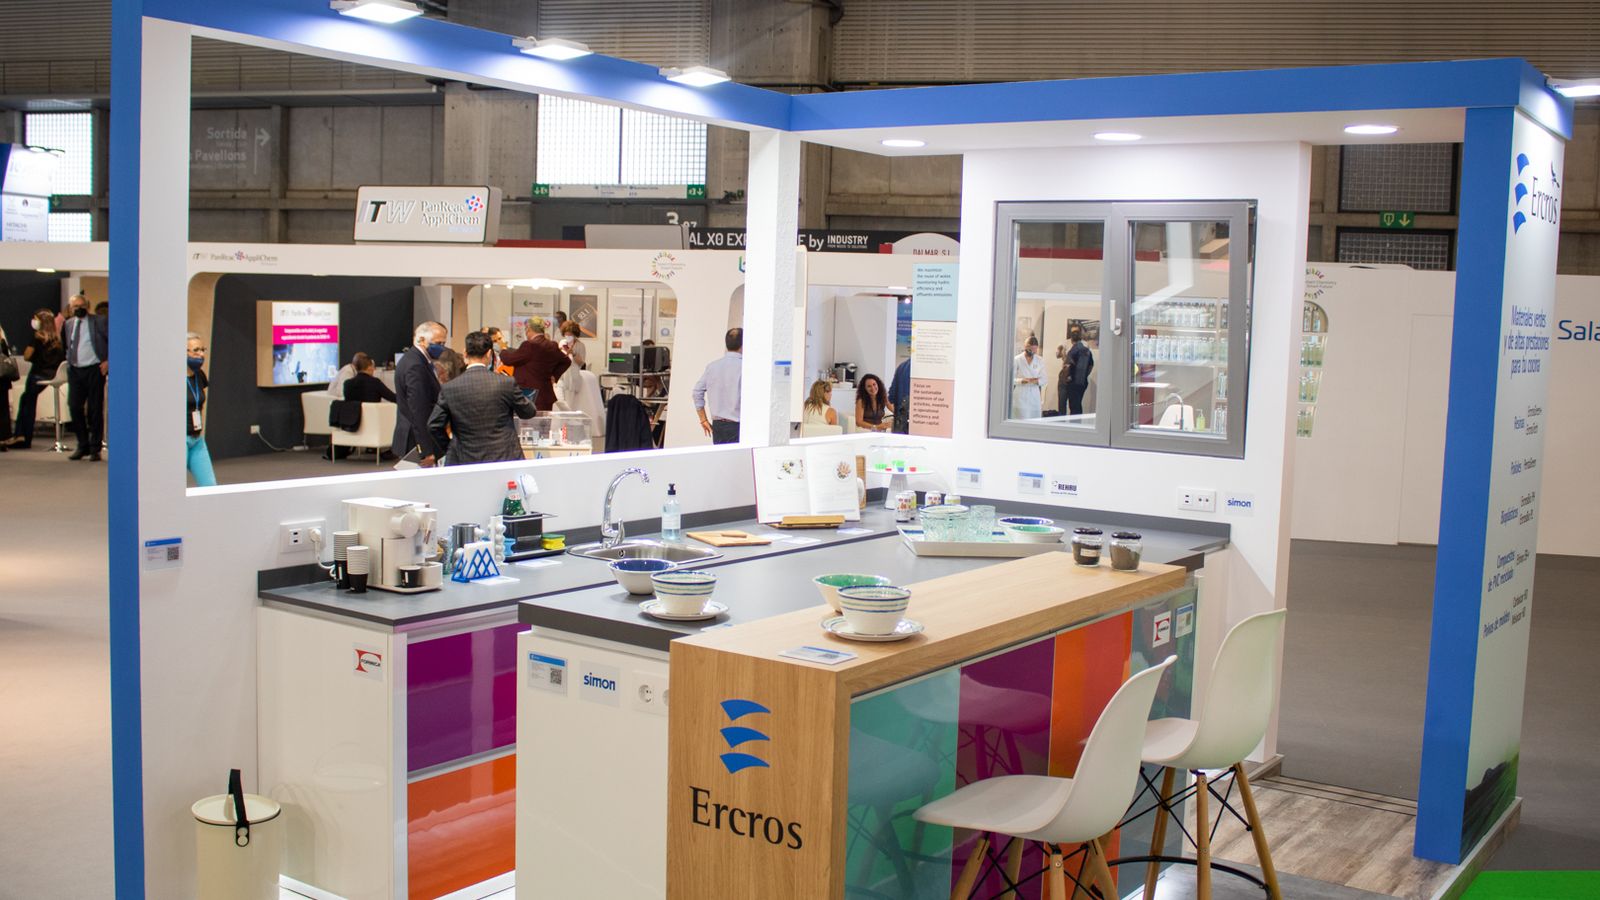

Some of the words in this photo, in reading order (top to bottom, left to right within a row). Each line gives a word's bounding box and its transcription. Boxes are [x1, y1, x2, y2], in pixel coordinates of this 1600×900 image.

[207, 127, 247, 140] Sortida
[195, 150, 247, 160] Pavellons
[1532, 176, 1558, 224] Ercros
[358, 200, 416, 223] ITW
[421, 201, 464, 212] PanReac
[421, 214, 479, 227] AppliChem
[809, 234, 824, 251] by
[827, 234, 868, 245] INDUSTRY
[1510, 359, 1521, 380] para
[1528, 354, 1540, 373] cocina
[1227, 498, 1251, 508] simon
[584, 672, 616, 691] simon
[688, 786, 803, 850] Ercros
